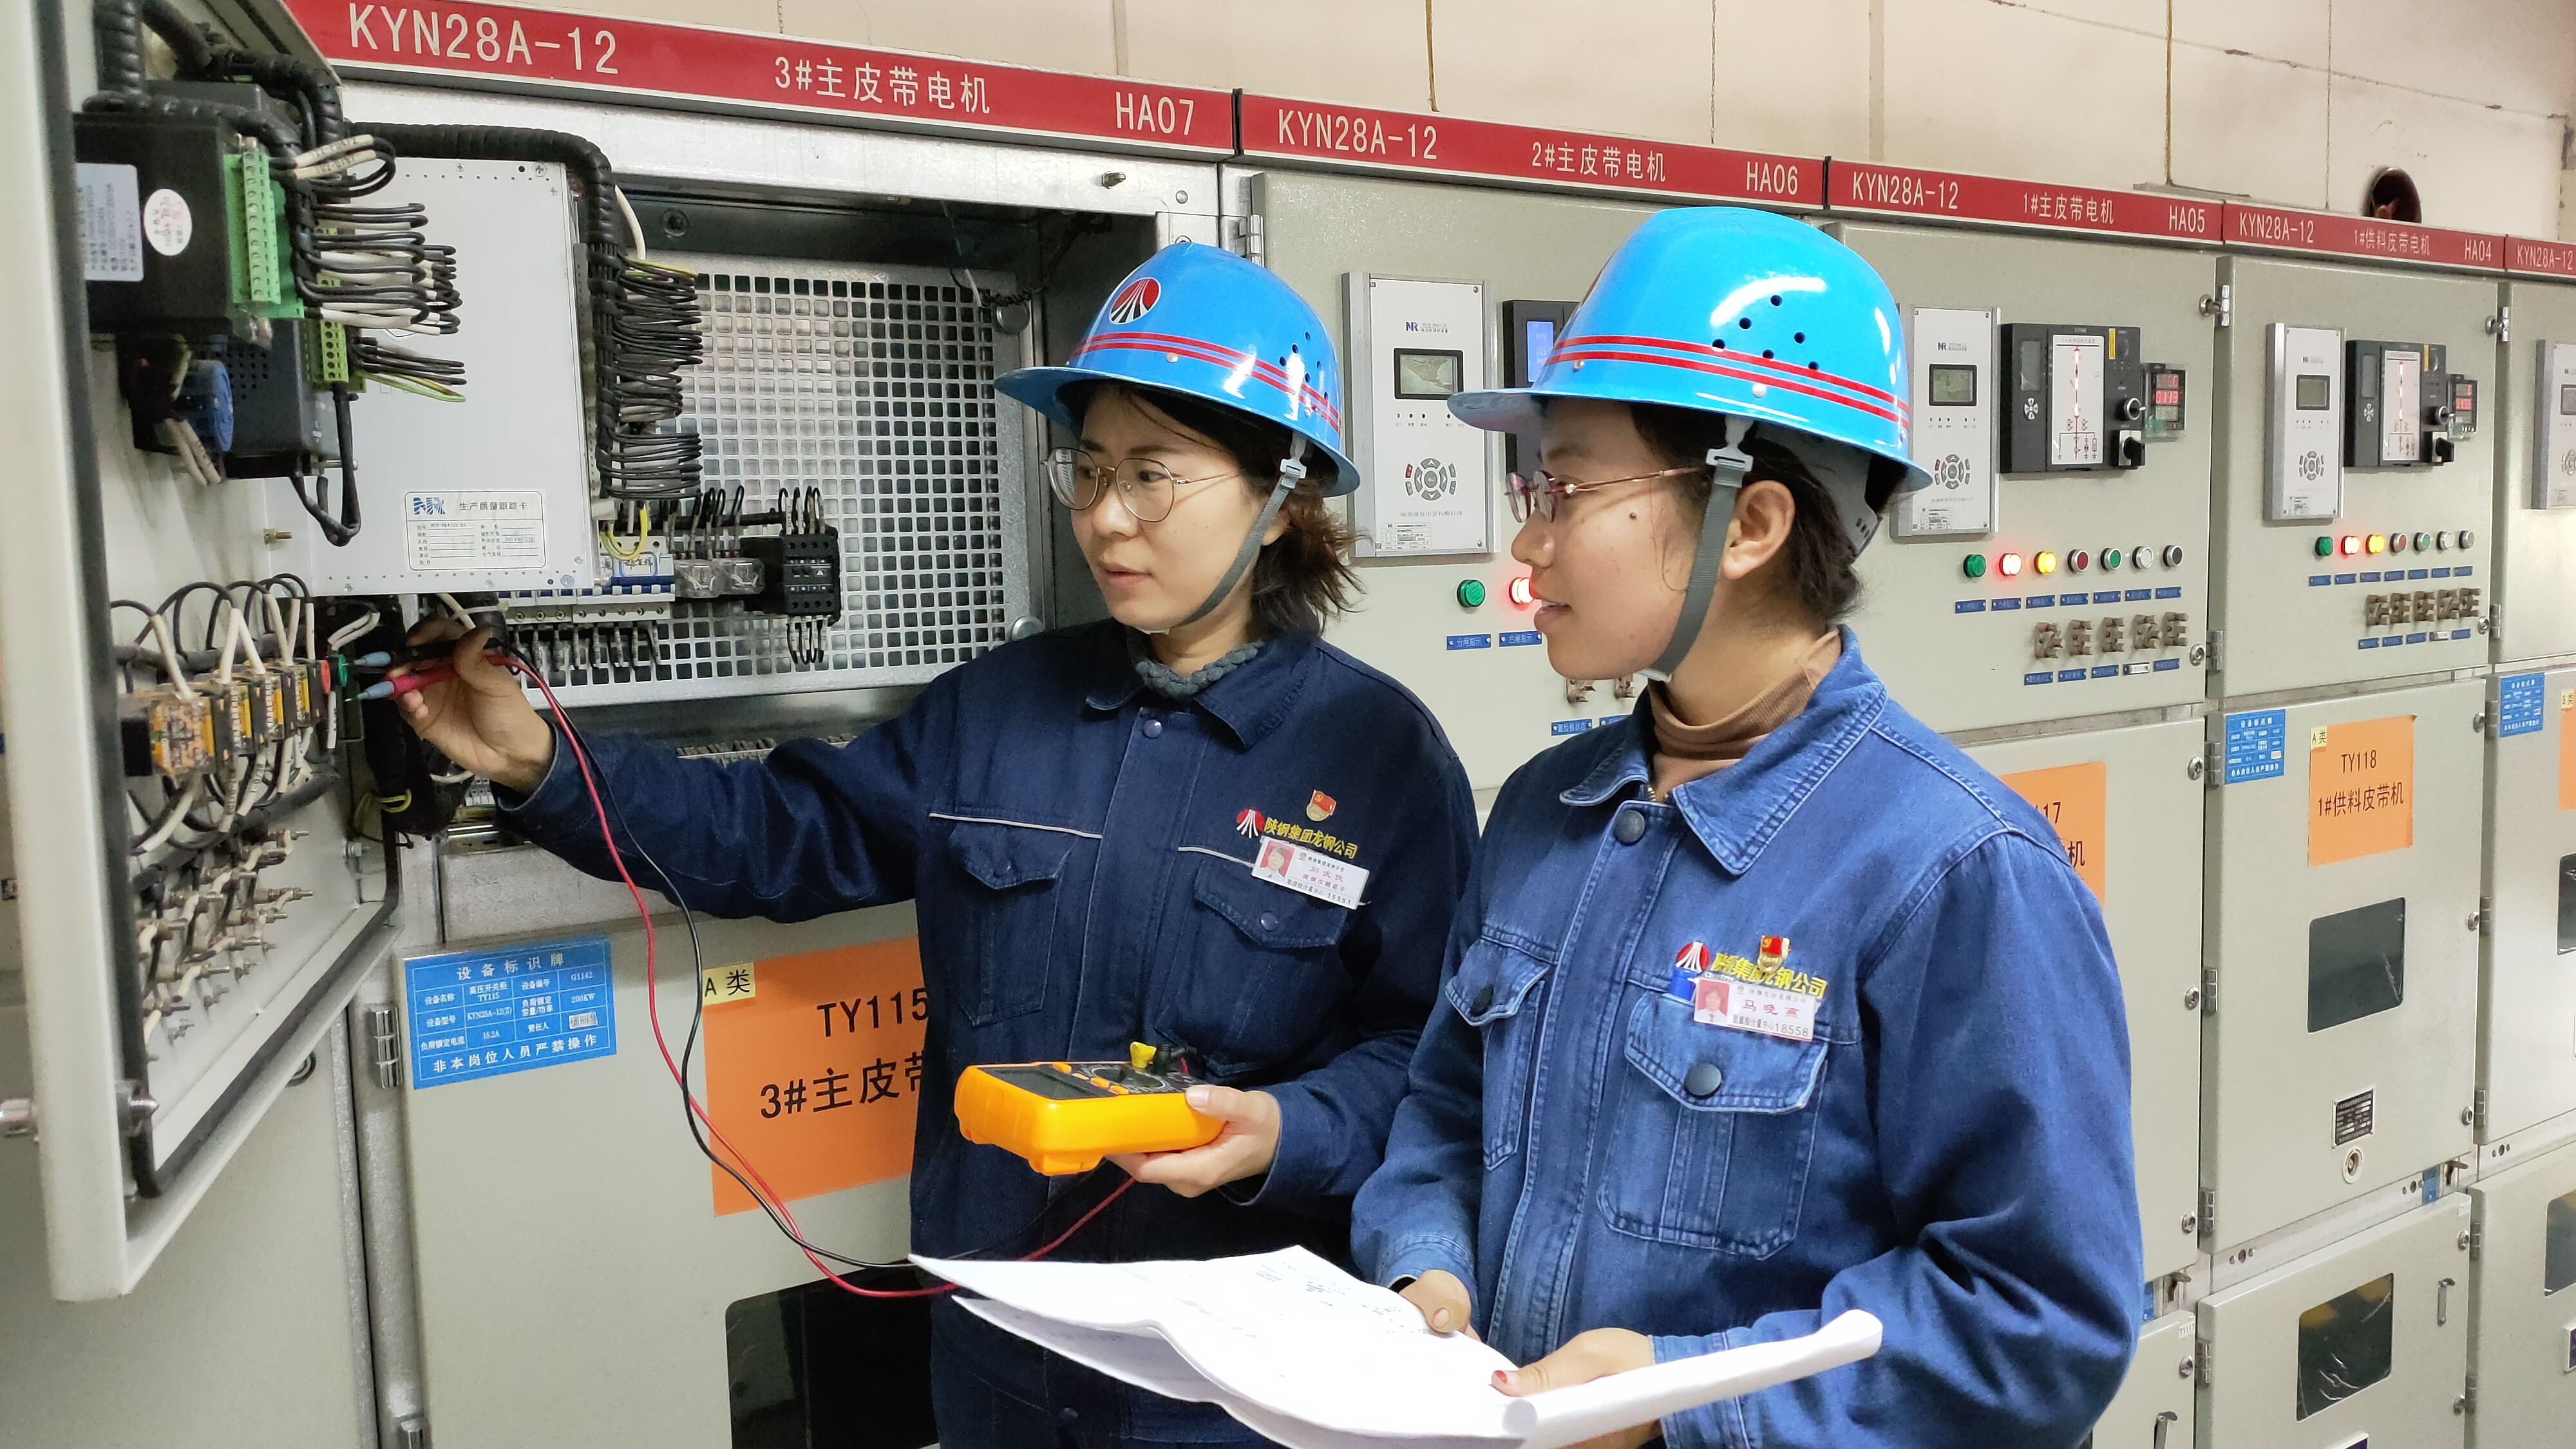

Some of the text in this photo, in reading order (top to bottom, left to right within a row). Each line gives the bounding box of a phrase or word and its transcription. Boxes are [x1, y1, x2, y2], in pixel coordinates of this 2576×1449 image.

[348, 3, 620, 75] KYN28A-12
[774, 55, 991, 115] 3#主皮带电机
[1114, 91, 1195, 137] HA07
[1278, 108, 1438, 161] KYN28A-12
[1531, 141, 1667, 183] 2#主皮带电机
[1746, 160, 1799, 196] HA06
[1852, 171, 1959, 210] KYN28A-12
[2022, 191, 2114, 225] 1#主皮带电机
[2168, 205, 2206, 234] HA05
[2239, 211, 2315, 245] KYN28A-12
[2354, 229, 2430, 257] 1#供料皮带电机
[2465, 240, 2492, 263] HA04
[2516, 244, 2573, 272] KYN28A-12
[459, 502, 527, 511] 生产质量跟踪卡
[2341, 750, 2377, 773] TY118
[2036, 802, 2061, 824] 17
[2318, 782, 2404, 817] 1#供料皮带机
[1264, 817, 1358, 859] 陕钢集团龙钢公司
[1328, 893, 1350, 905] 15551
[456, 953, 564, 980] 设备标识牌
[469, 981, 507, 995] 高压开关柜
[478, 992, 500, 1001] TY115
[522, 979, 550, 990] 设备编号
[705, 969, 750, 997] A 类
[425, 993, 455, 1005] 设备名称
[571, 993, 595, 1003] 200KW
[426, 1014, 456, 1027] 设备型号
[817, 988, 927, 1037] TY115
[1775, 1023, 1809, 1037] 18558
[433, 1034, 597, 1074] 非本岗位人员严禁操作
